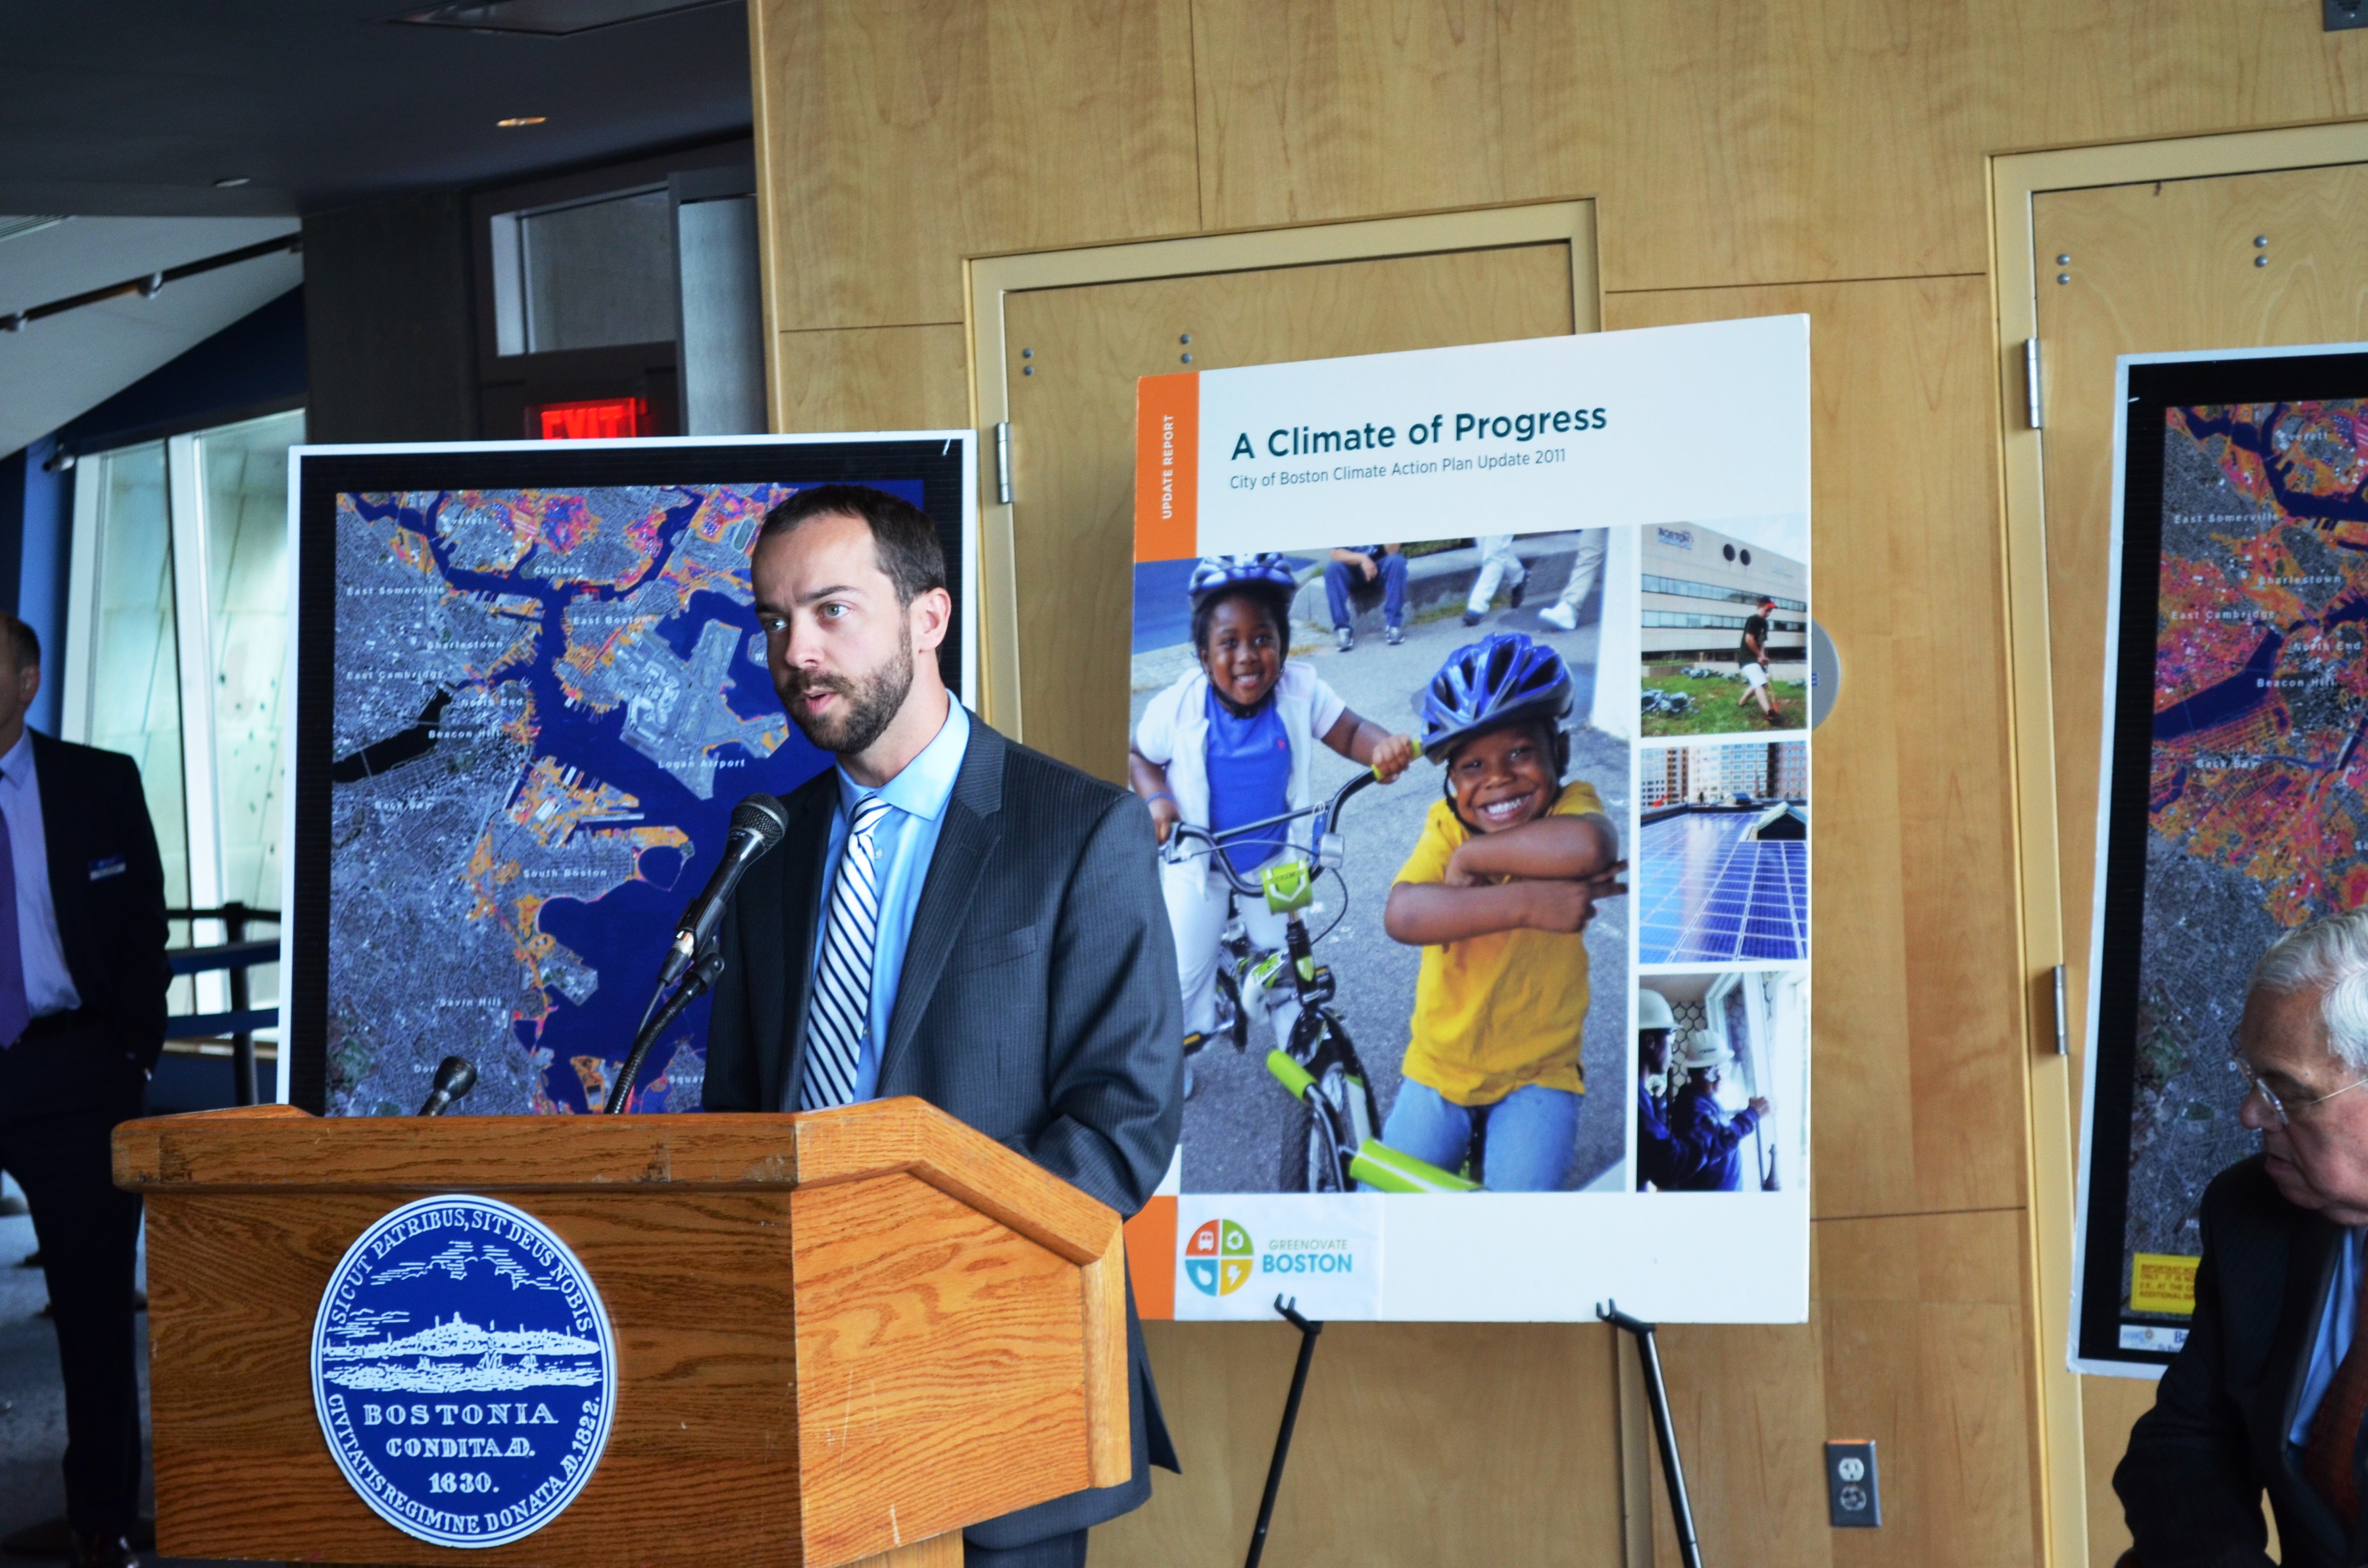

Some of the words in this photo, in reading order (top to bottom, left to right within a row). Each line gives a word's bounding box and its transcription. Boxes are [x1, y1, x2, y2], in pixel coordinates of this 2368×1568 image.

[1163, 414, 1174, 466] REPORT
[1231, 432, 1256, 461] A
[1268, 423, 1396, 457] Climate
[1408, 413, 1443, 445] of
[1455, 407, 1607, 443] Progress
[1230, 474, 1257, 490] City
[1262, 472, 1276, 487] of
[1281, 470, 1329, 486] Boston
[1333, 464, 1387, 481] Climate
[1392, 459, 1438, 477] Action
[1442, 457, 1473, 472] Plan
[1477, 452, 1531, 471] Update
[1535, 448, 1566, 464] 2011
[1162, 468, 1173, 519] UPDATE
[2174, 514, 2203, 525] East
[2208, 512, 2280, 523] Somerville
[534, 566, 583, 575] Chelsea
[2258, 575, 2342, 585] Charlestown
[346, 586, 374, 596] East
[379, 585, 445, 596] Somerville
[573, 616, 600, 626] East
[604, 615, 652, 625] Boston
[2171, 611, 2200, 620] East
[2205, 610, 2276, 622] Cambridge
[427, 640, 504, 650] Charlestown
[2337, 641, 2362, 651] End
[2256, 678, 2305, 688] Beacon
[500, 697, 523, 706] End
[428, 729, 473, 739] Beacon
[658, 760, 695, 771] Logan
[700, 758, 745, 770] Airport
[2195, 758, 2228, 769] Back
[523, 869, 558, 879] South
[563, 868, 607, 878] Boston
[1269, 1239, 1348, 1251] GREENOVATE
[1262, 1253, 1353, 1274] BOSTON
[331, 1255, 373, 1325] SICUT
[370, 1208, 469, 1259] PATRIBUS,
[471, 1210, 507, 1235] SIT
[505, 1223, 555, 1267] DEUS
[549, 1262, 593, 1339] NOBIS.
[363, 1403, 559, 1426] BOSTONIA
[386, 1437, 504, 1458] CONDITA
[327, 1393, 386, 1492] CIVITATIS
[381, 1482, 481, 1534] REGIMINE
[484, 1475, 568, 1531] DONATA
[428, 1471, 500, 1494] 1630.
